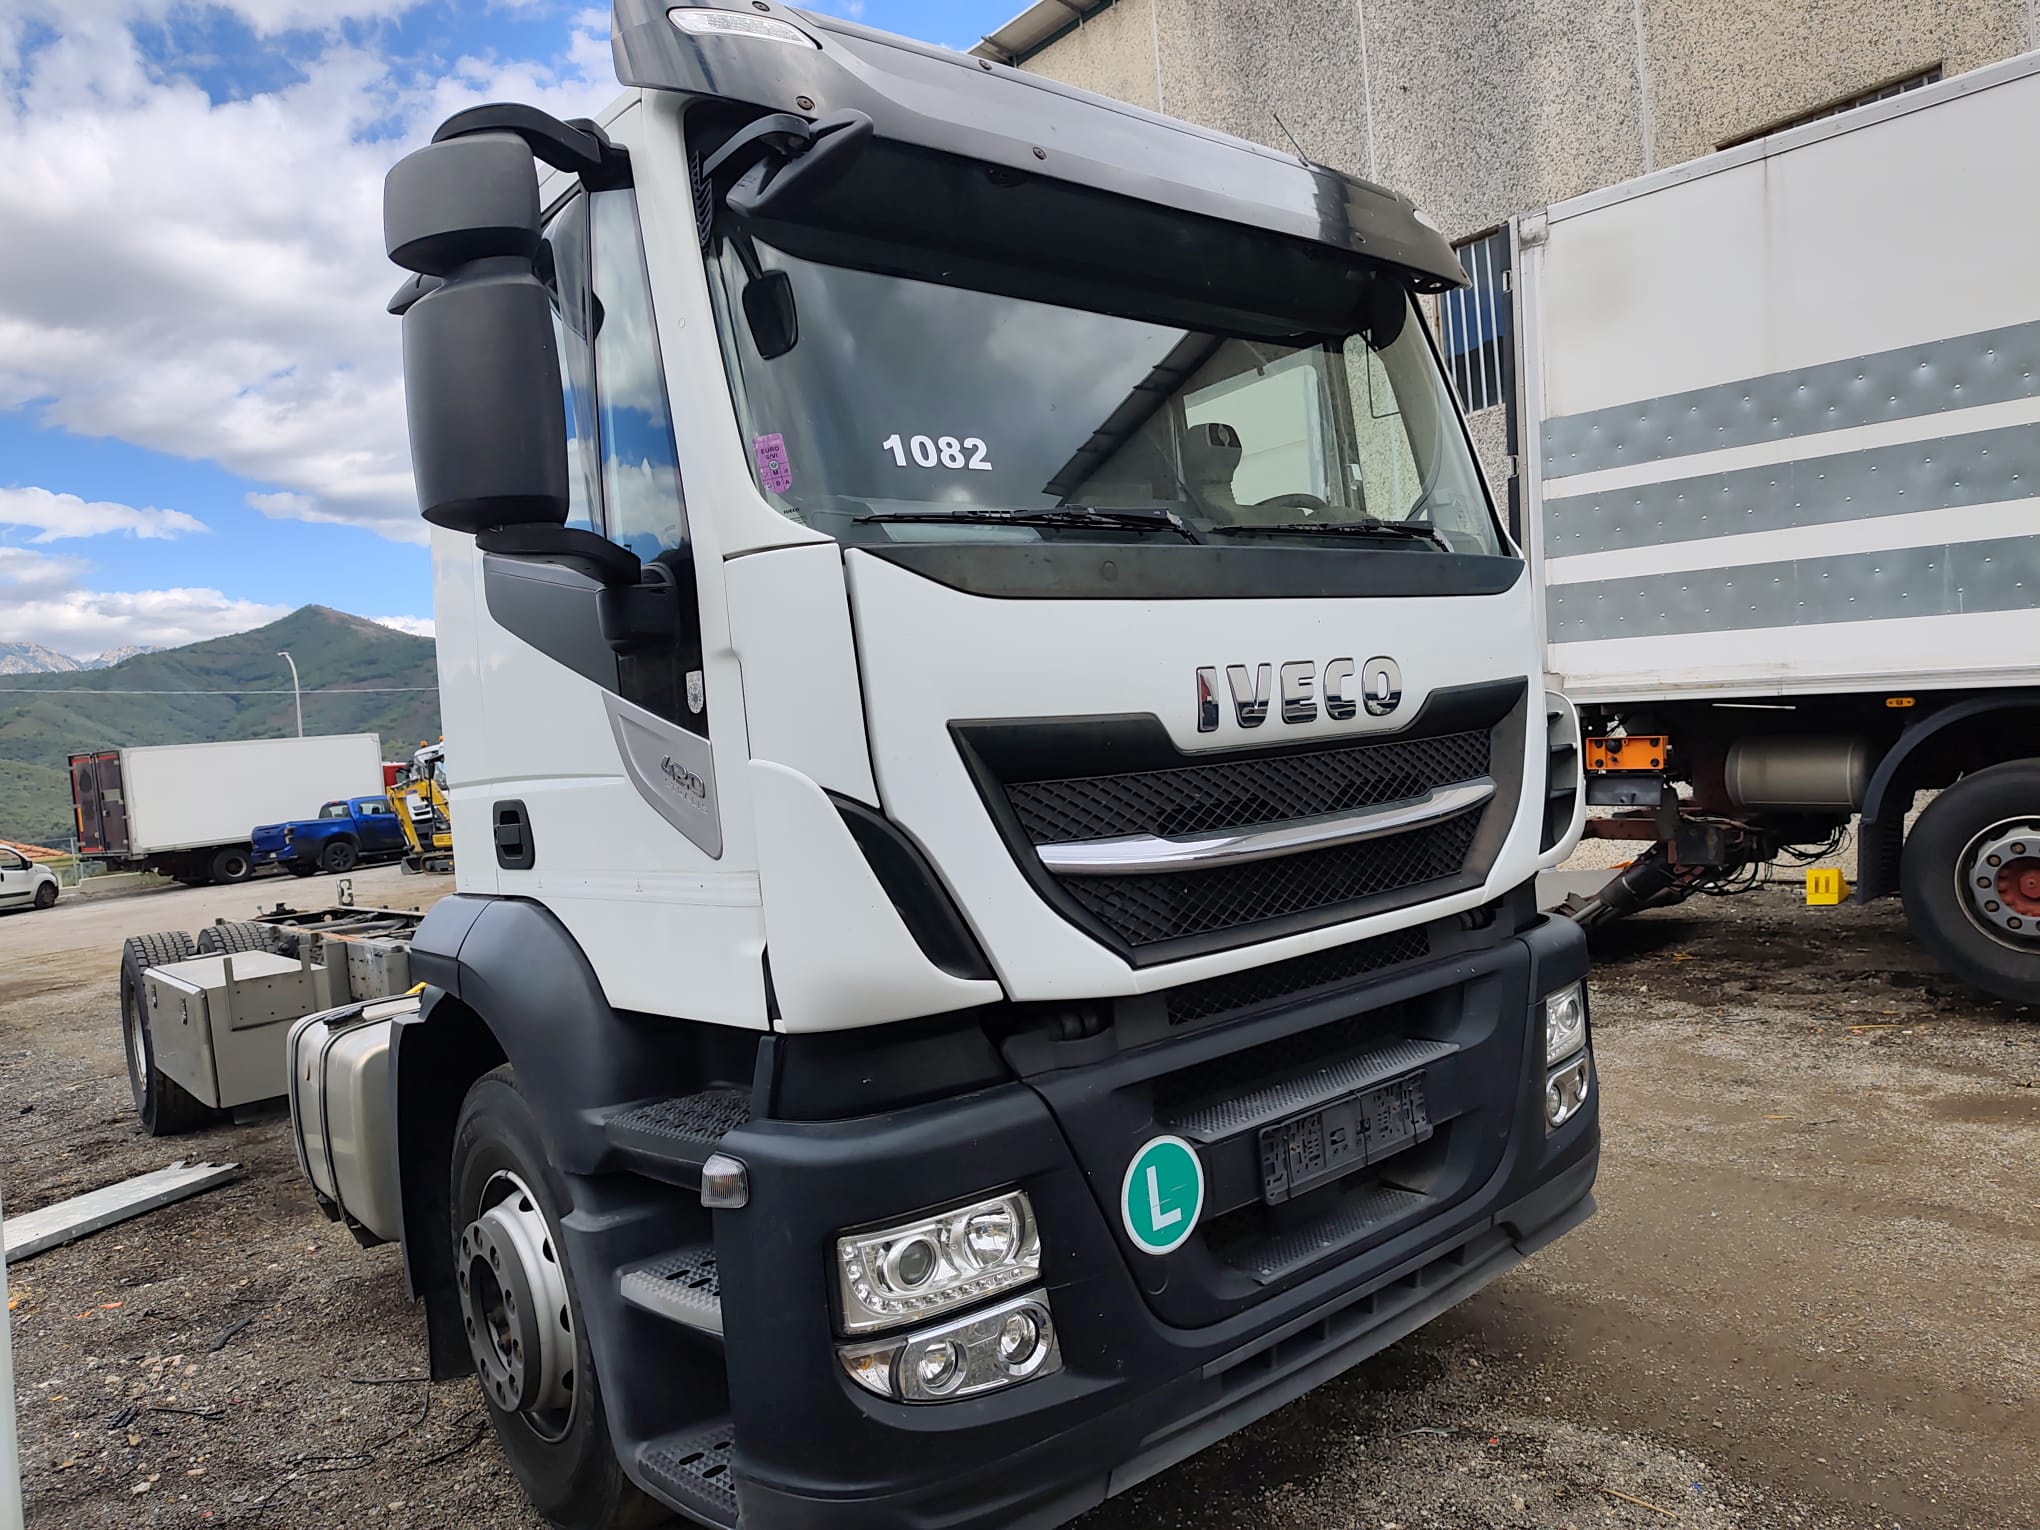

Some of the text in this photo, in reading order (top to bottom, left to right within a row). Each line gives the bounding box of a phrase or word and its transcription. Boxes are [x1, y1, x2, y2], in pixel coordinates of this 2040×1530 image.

[760, 446, 780, 454] EURO
[882, 434, 993, 471] 1082
[1195, 655, 1402, 733] IVECO
[1146, 1165, 1183, 1232] L
